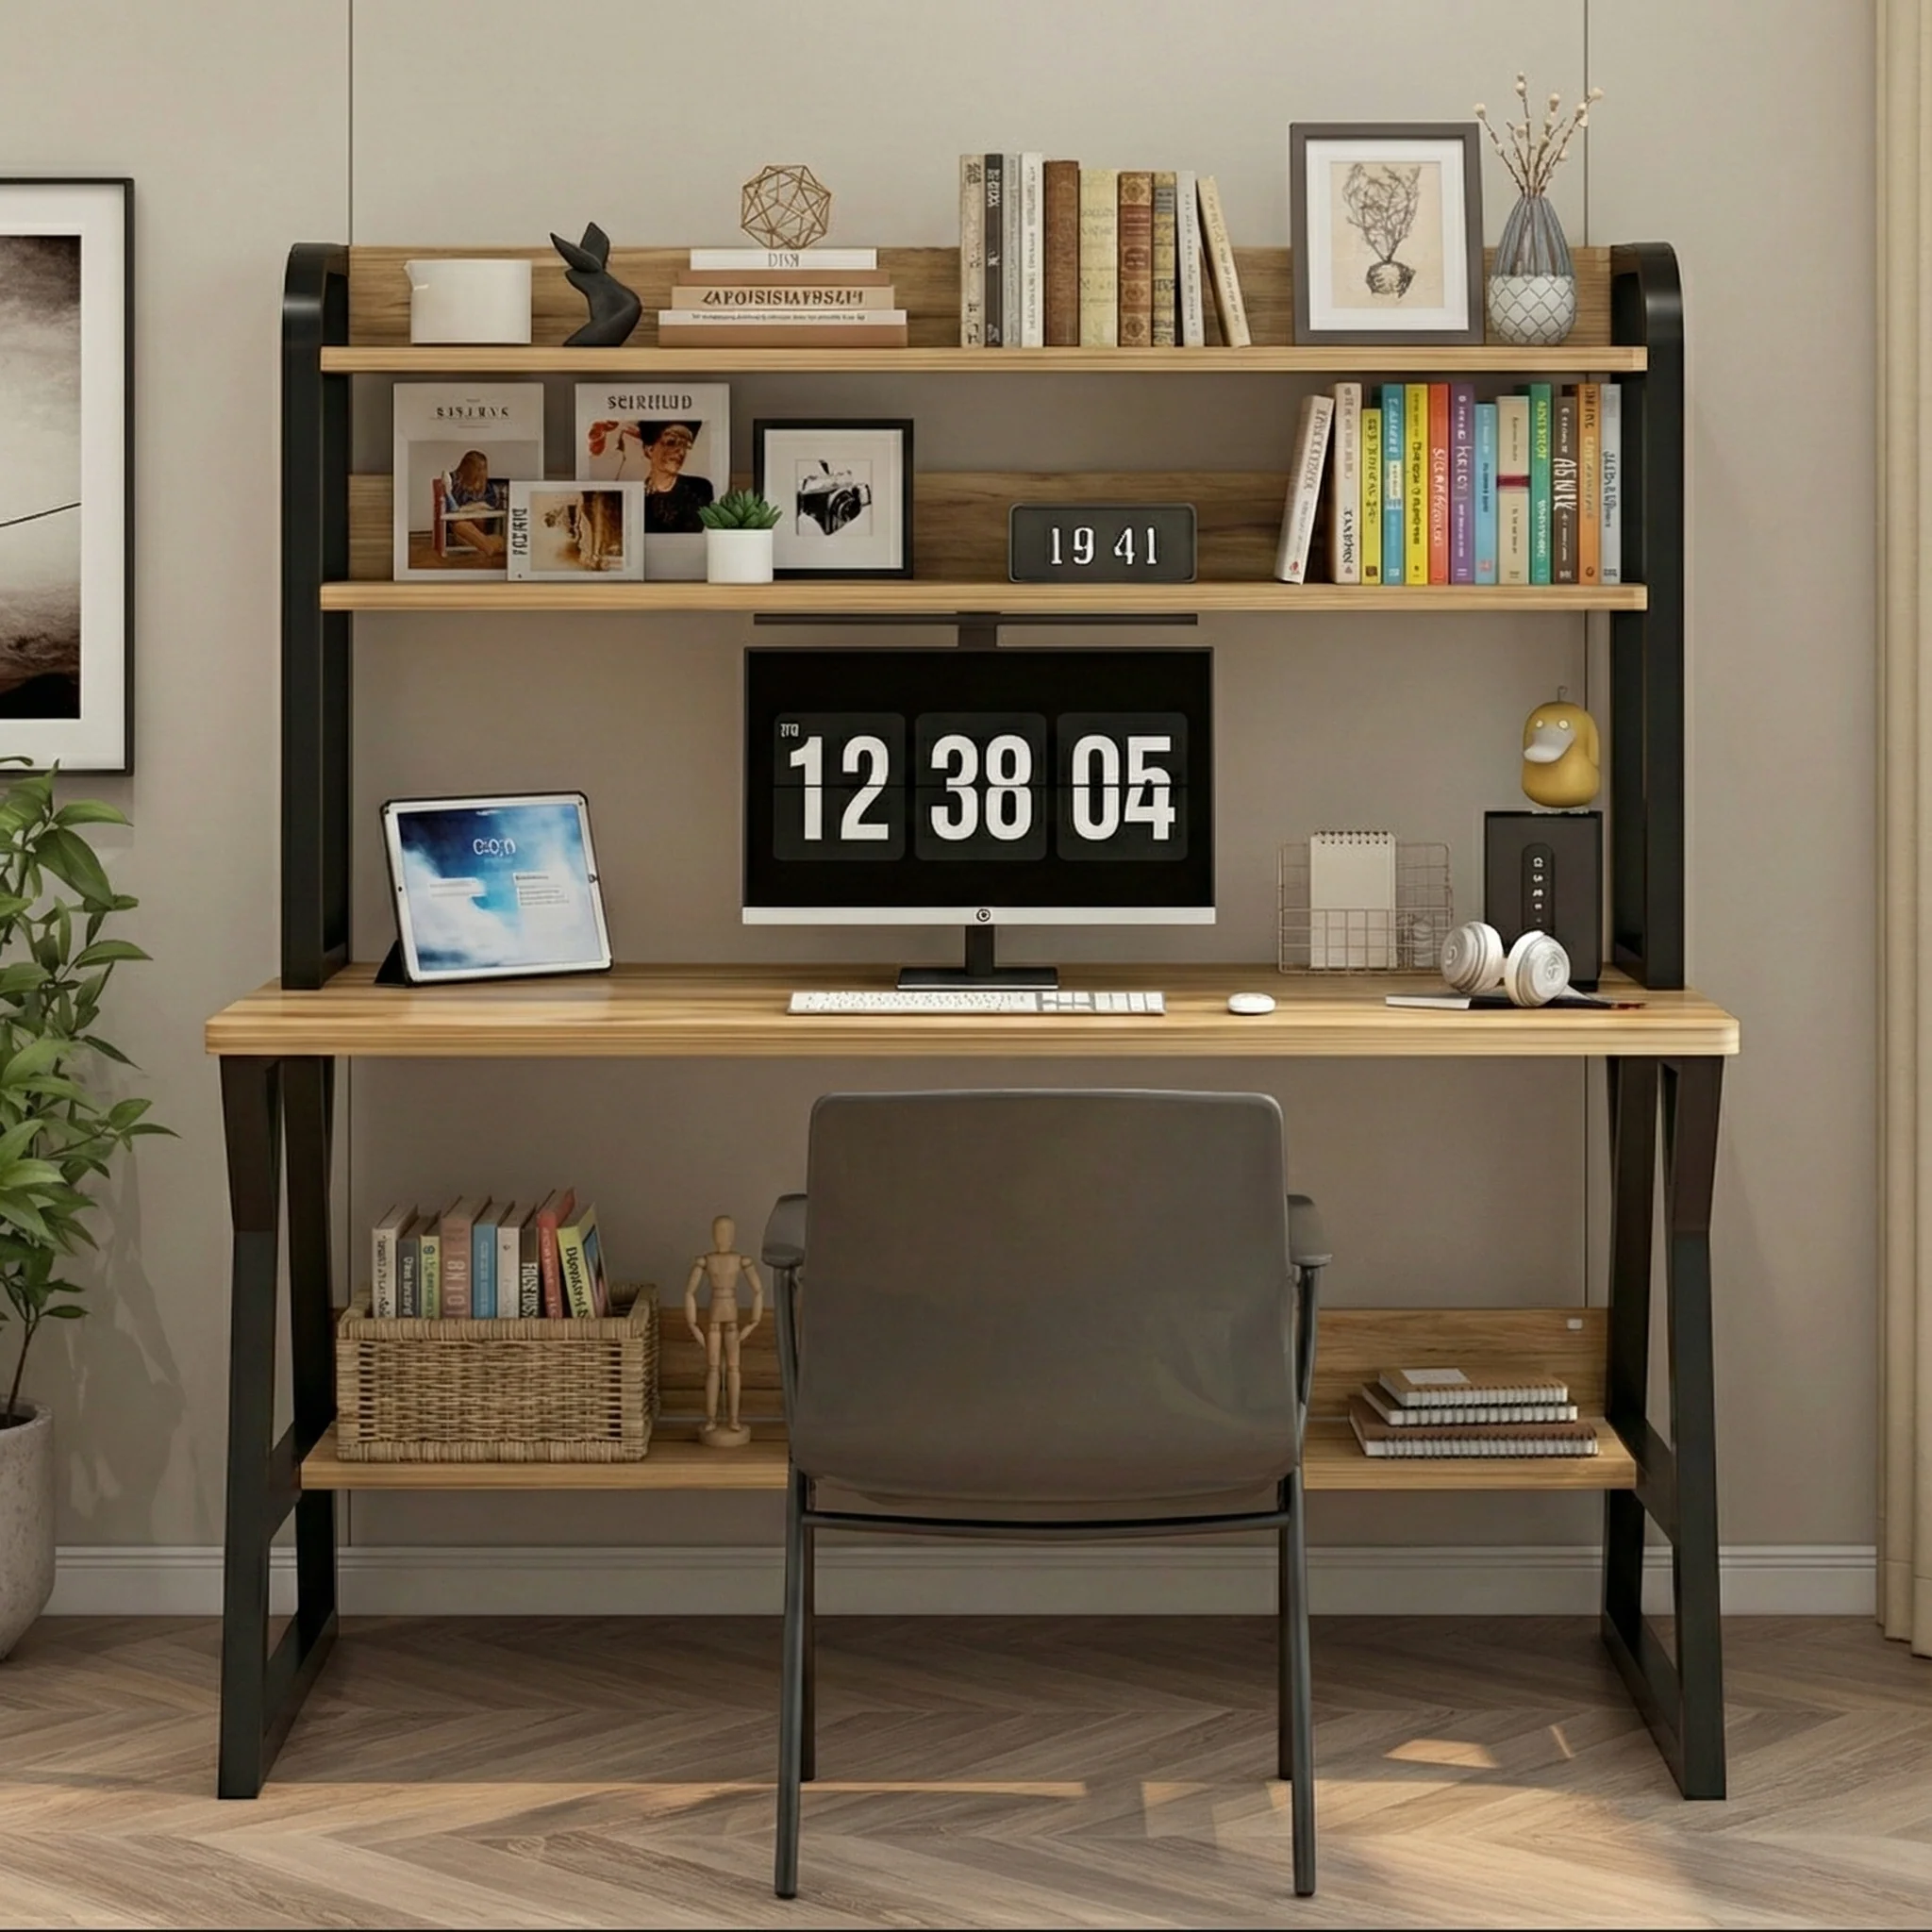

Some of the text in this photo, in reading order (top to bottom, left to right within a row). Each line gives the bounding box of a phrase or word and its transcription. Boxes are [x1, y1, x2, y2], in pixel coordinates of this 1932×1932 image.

[1051, 526, 1158, 565] 19 41
[790, 736, 890, 841] 12
[930, 734, 1033, 841] 38
